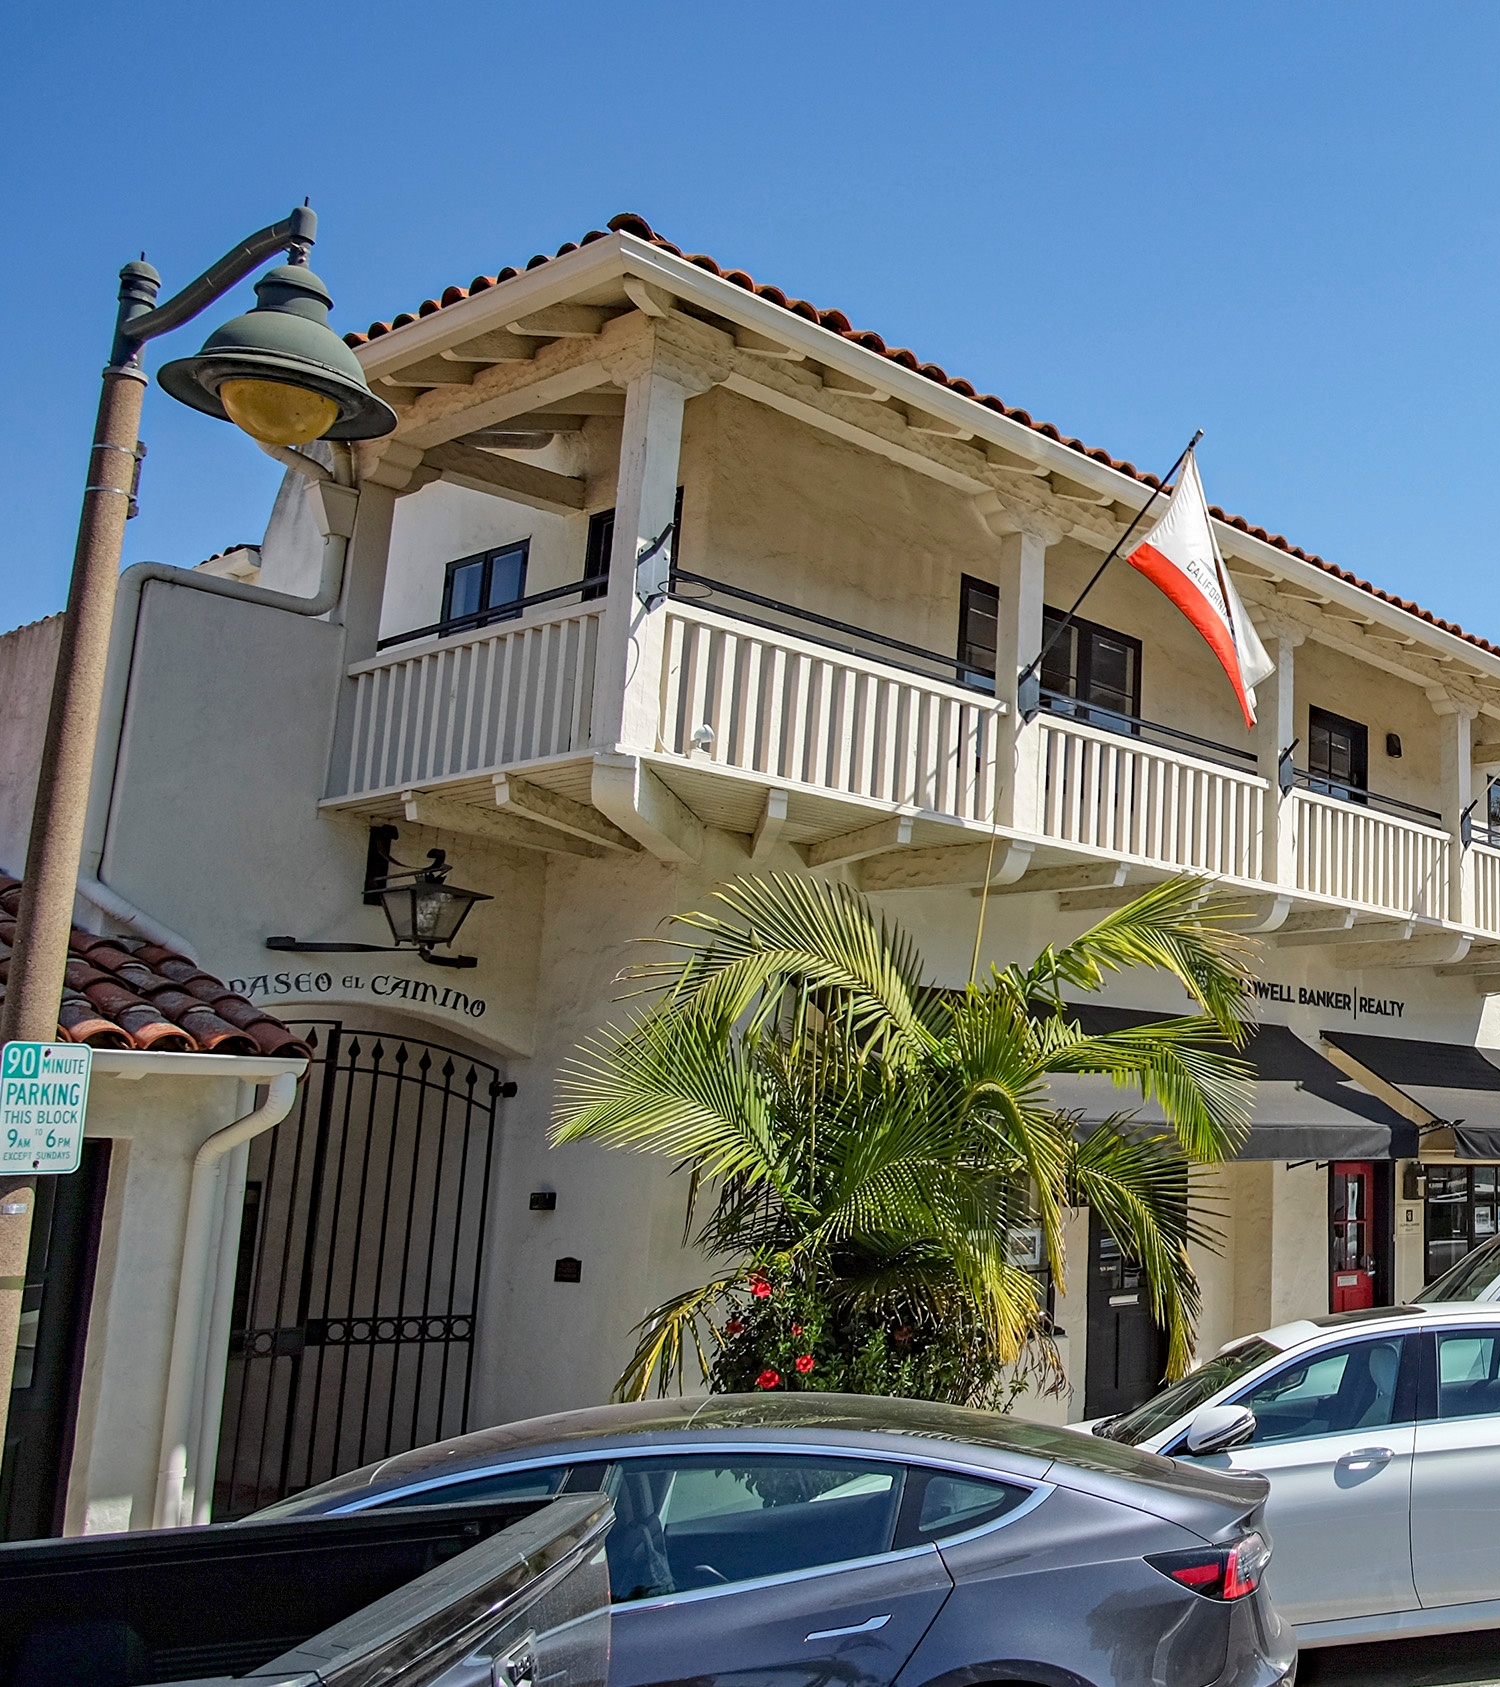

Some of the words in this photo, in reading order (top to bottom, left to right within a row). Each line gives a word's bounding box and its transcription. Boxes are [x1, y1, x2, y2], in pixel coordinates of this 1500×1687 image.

[227, 971, 333, 998] PASEO
[342, 975, 365, 989] EL
[371, 975, 487, 1018] CAMINO
[1298, 987, 1351, 1011] BANKER
[1359, 997, 1405, 1018] REALTY
[8, 1047, 36, 1076] 90
[41, 1058, 85, 1075] MINUTE
[6, 1082, 81, 1107] PARKING
[4, 1110, 32, 1124] THIS
[37, 1110, 79, 1124] BLOCK
[35, 1128, 43, 1136] TO
[3, 1151, 33, 1161] EXCEPT
[35, 1151, 71, 1160] SUNDAYS
